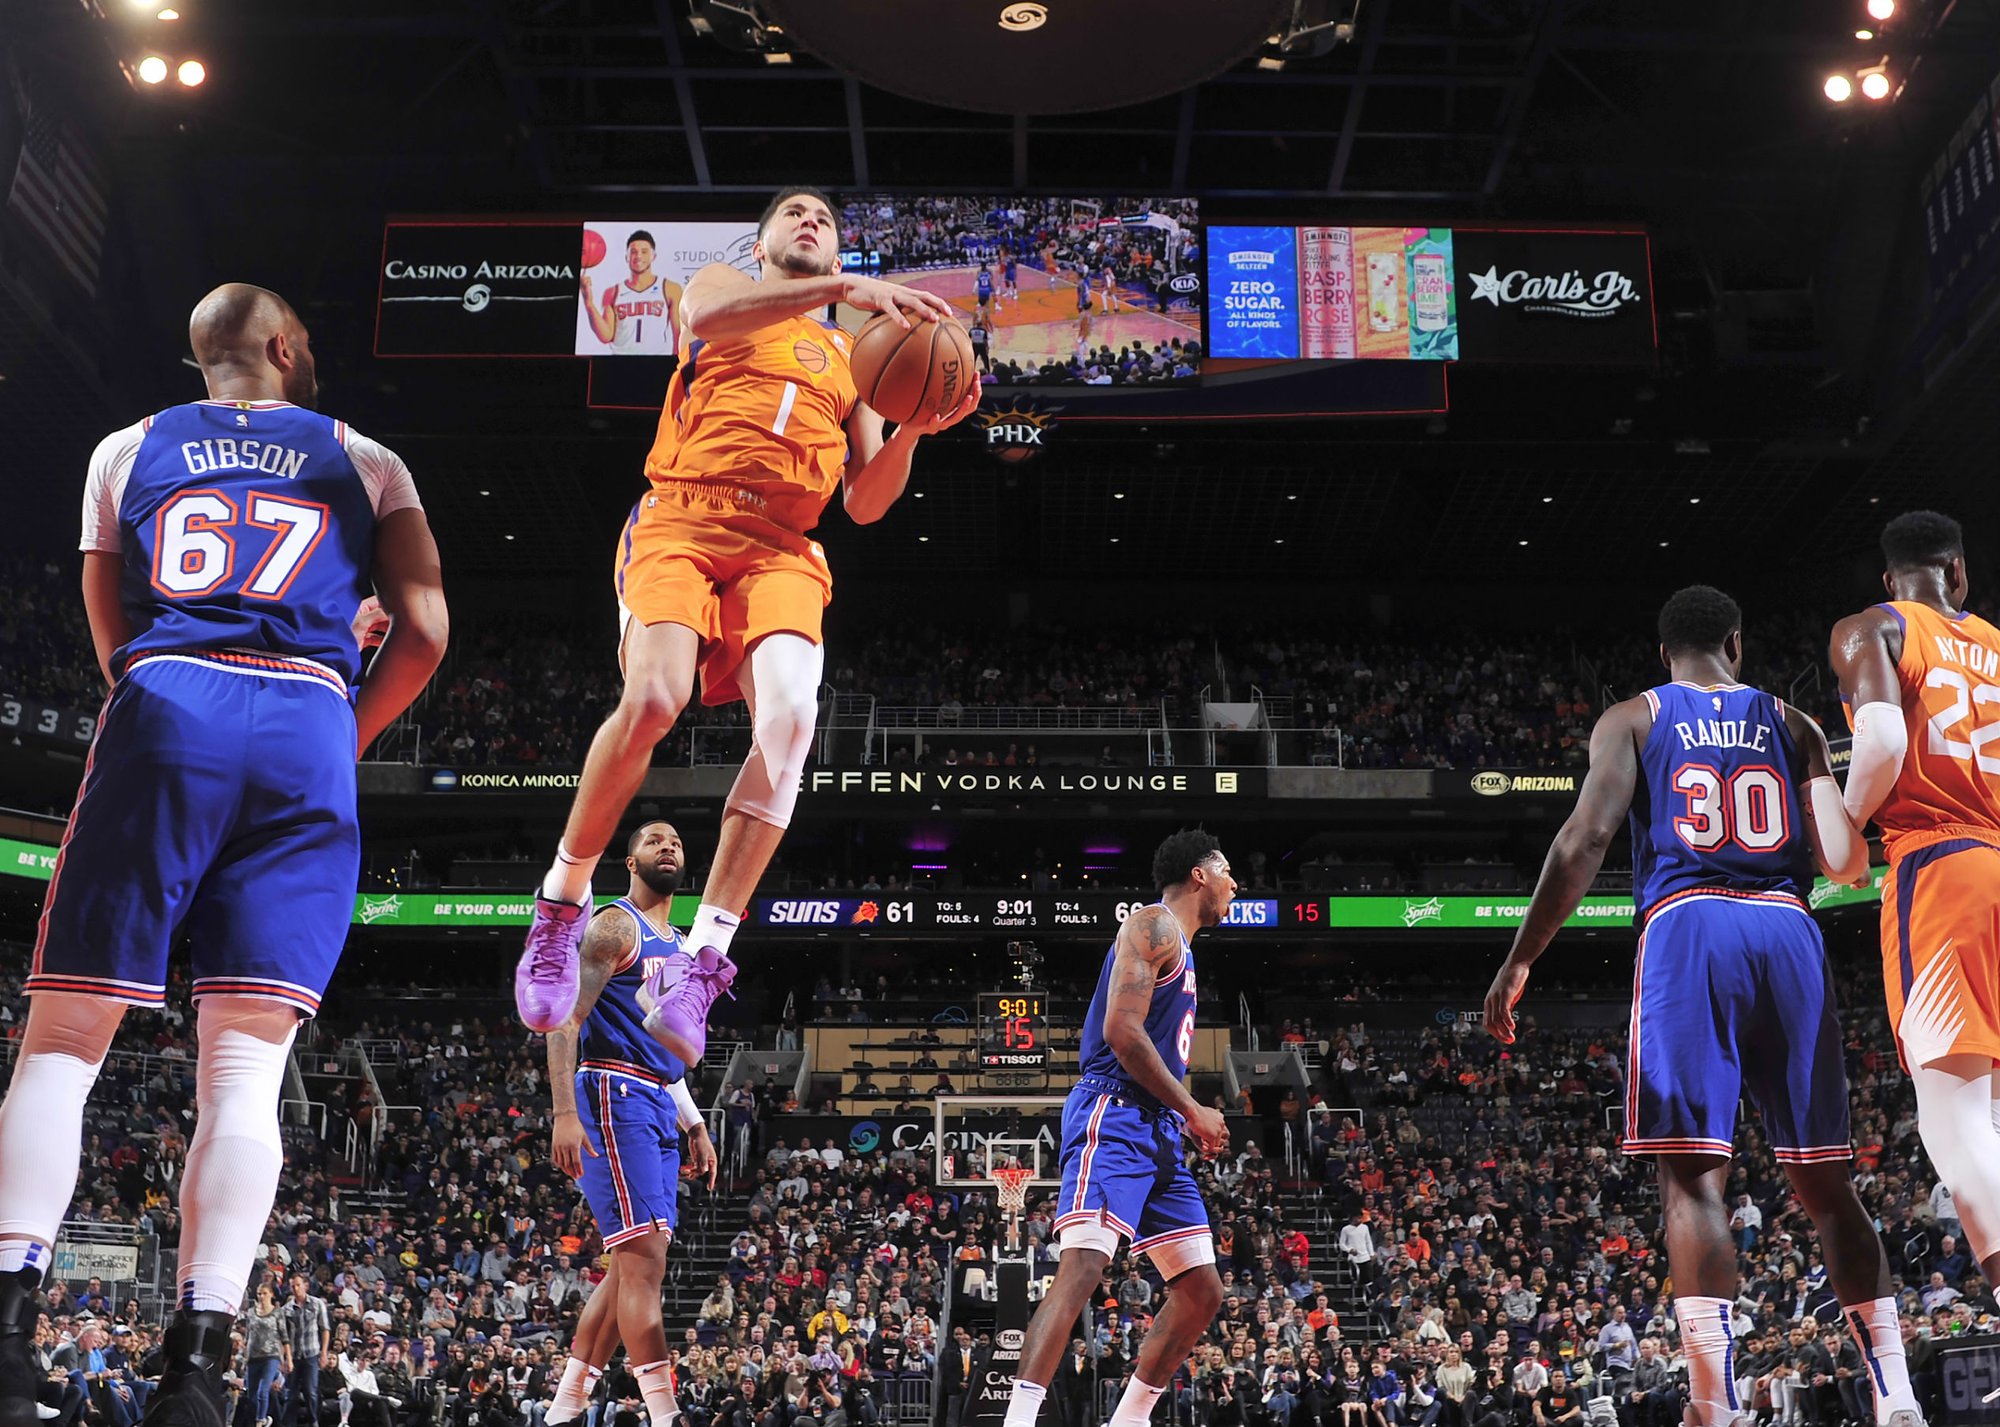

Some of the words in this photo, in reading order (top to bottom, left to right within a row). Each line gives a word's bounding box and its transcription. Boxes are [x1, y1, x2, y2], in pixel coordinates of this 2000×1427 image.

[673, 251, 725, 262] STUDIO
[1231, 253, 1271, 261] SMIRNOFF
[384, 260, 468, 279] CASINO
[473, 260, 574, 279] ARIZONA
[1175, 279, 1195, 290] KIA
[1303, 271, 1351, 287] RASP-
[1230, 281, 1275, 294] ZERO
[1500, 270, 1589, 303] Carl's
[1590, 271, 1641, 304] Jr.
[1224, 295, 1286, 310] SUGAR.
[1304, 288, 1353, 305] BERRY
[1230, 311, 1246, 319] ALL
[1248, 311, 1277, 319] KINDS
[635, 319, 642, 343] 1
[1226, 320, 1240, 328] OF
[770, 381, 798, 437] 1
[987, 424, 1043, 446] PHX
[181, 438, 308, 480] GIBSON
[151, 488, 330, 601] 67
[1934, 635, 1999, 678] AYTON
[0, 701, 22, 726] 3
[38, 709, 59, 733] 3
[74, 716, 96, 741] 3
[1674, 718, 1771, 754] RANDLE
[461, 775, 519, 788] KONICA
[522, 775, 583, 788] MINOLT
[799, 771, 921, 793] FFEN
[936, 775, 1046, 790] VODKA
[1060, 775, 1188, 791] LOUNGE
[1480, 777, 1502, 786] FOX
[1511, 777, 1574, 791] ARIZONA
[1672, 762, 1790, 853] 30
[18, 851, 37, 866] BE
[364, 901, 397, 917] Sprite
[434, 904, 453, 915] BE
[455, 904, 494, 915] YOUR
[497, 904, 535, 916] ONLY
[769, 901, 841, 923] SUNS
[886, 901, 915, 923] 61
[937, 903, 953, 911] TO:
[997, 900, 1033, 915] 9:01
[1055, 903, 1072, 911] TO:
[1073, 903, 1079, 911] 4
[1294, 903, 1320, 922] 15
[1406, 905, 1441, 918] Sprite
[1475, 906, 1494, 917] BE
[936, 914, 971, 924] FOULS:
[973, 915, 979, 924] 4
[992, 916, 1027, 926] Quarter
[1030, 916, 1037, 926] 3
[1054, 914, 1091, 924] FOULS:
[1092, 915, 1097, 924] 1
[998, 999, 1039, 1017] 9:01
[1005, 1018, 1035, 1049] 15
[1176, 1009, 1195, 1065] 6
[999, 1055, 1044, 1065] TISSOT
[1003, 1333, 1021, 1342] FOX
